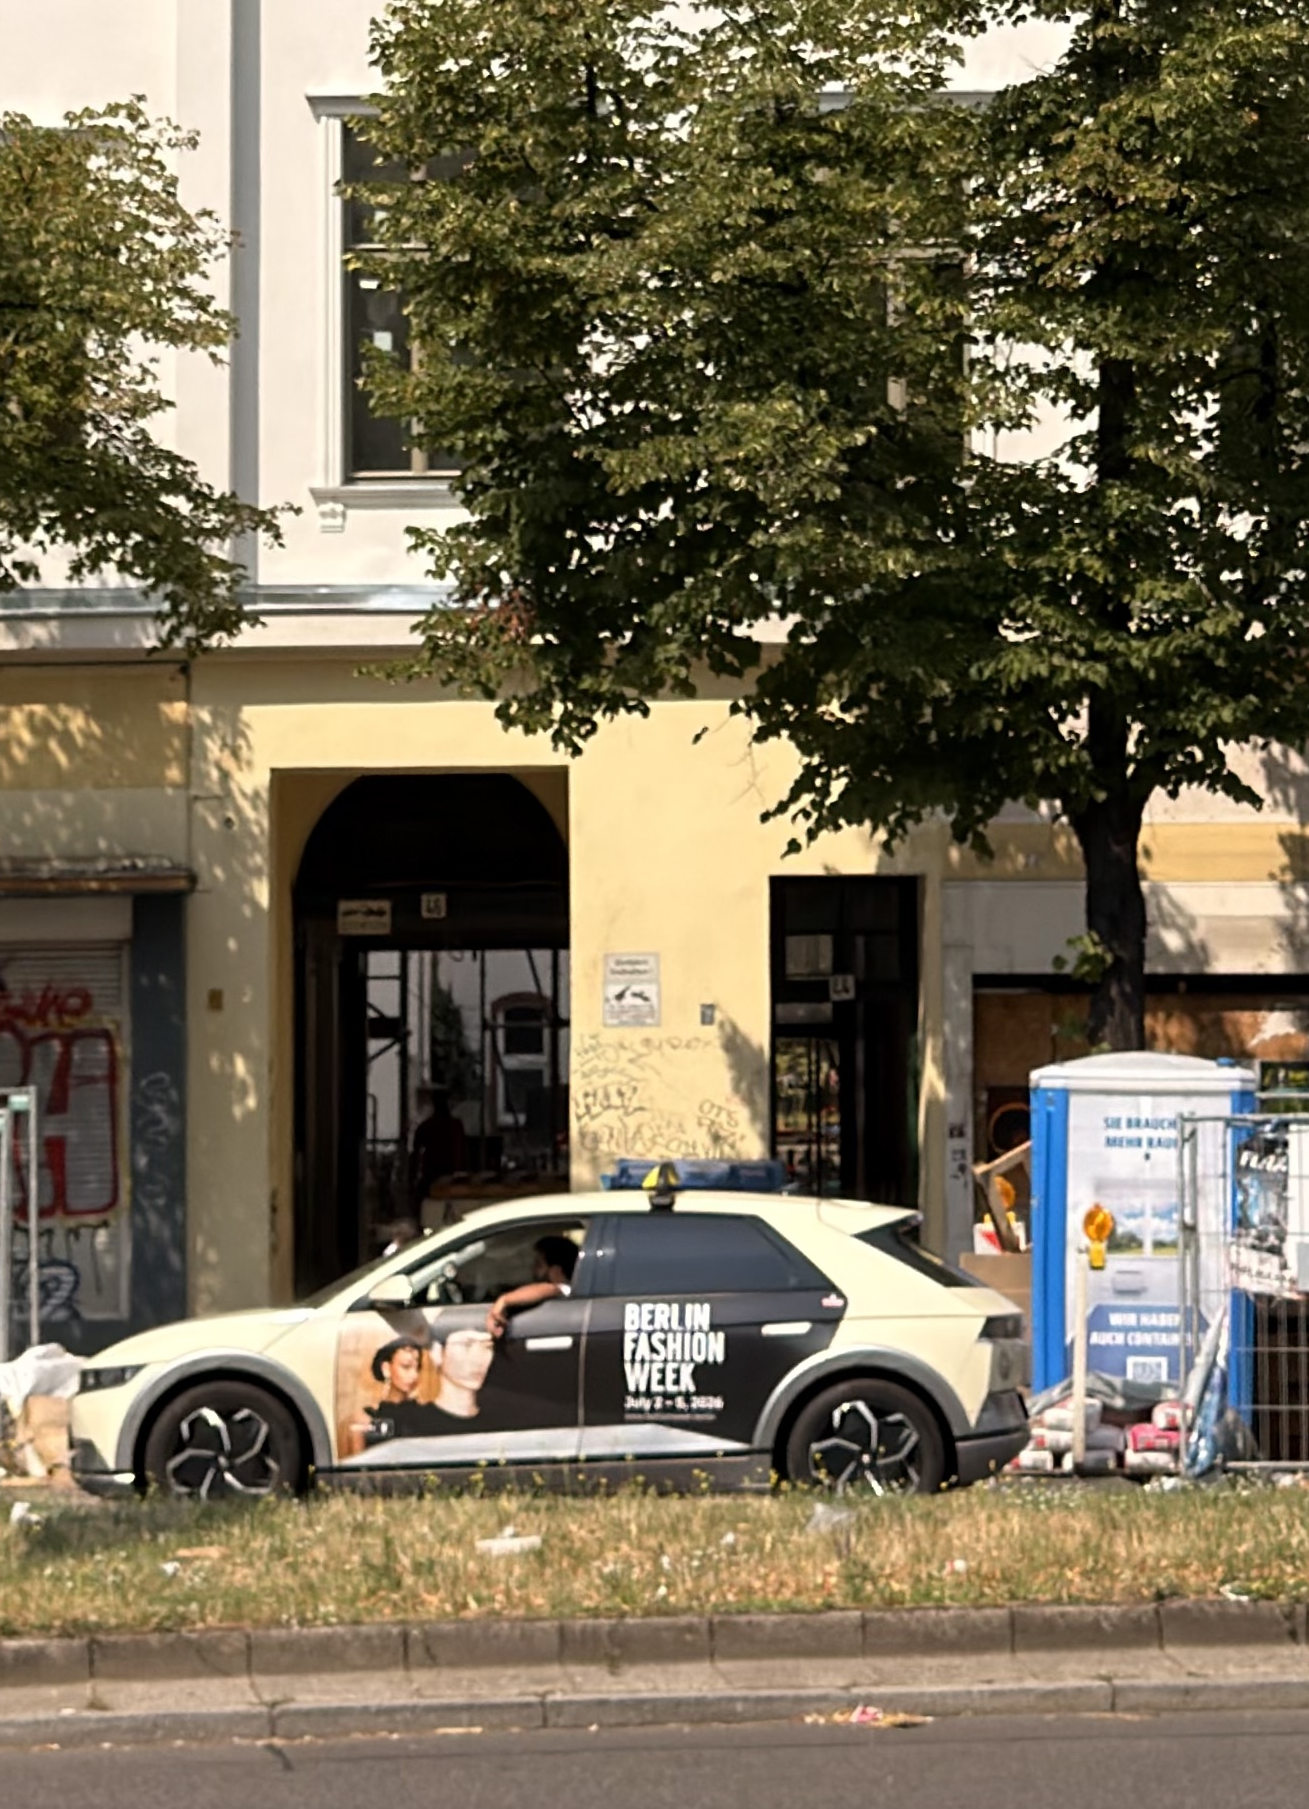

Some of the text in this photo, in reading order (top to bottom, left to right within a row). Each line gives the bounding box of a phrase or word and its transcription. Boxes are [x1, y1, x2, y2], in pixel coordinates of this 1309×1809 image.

[624, 1302, 711, 1331] BERLIN
[623, 1331, 725, 1364] FASHION
[623, 1362, 696, 1393] WEEK
